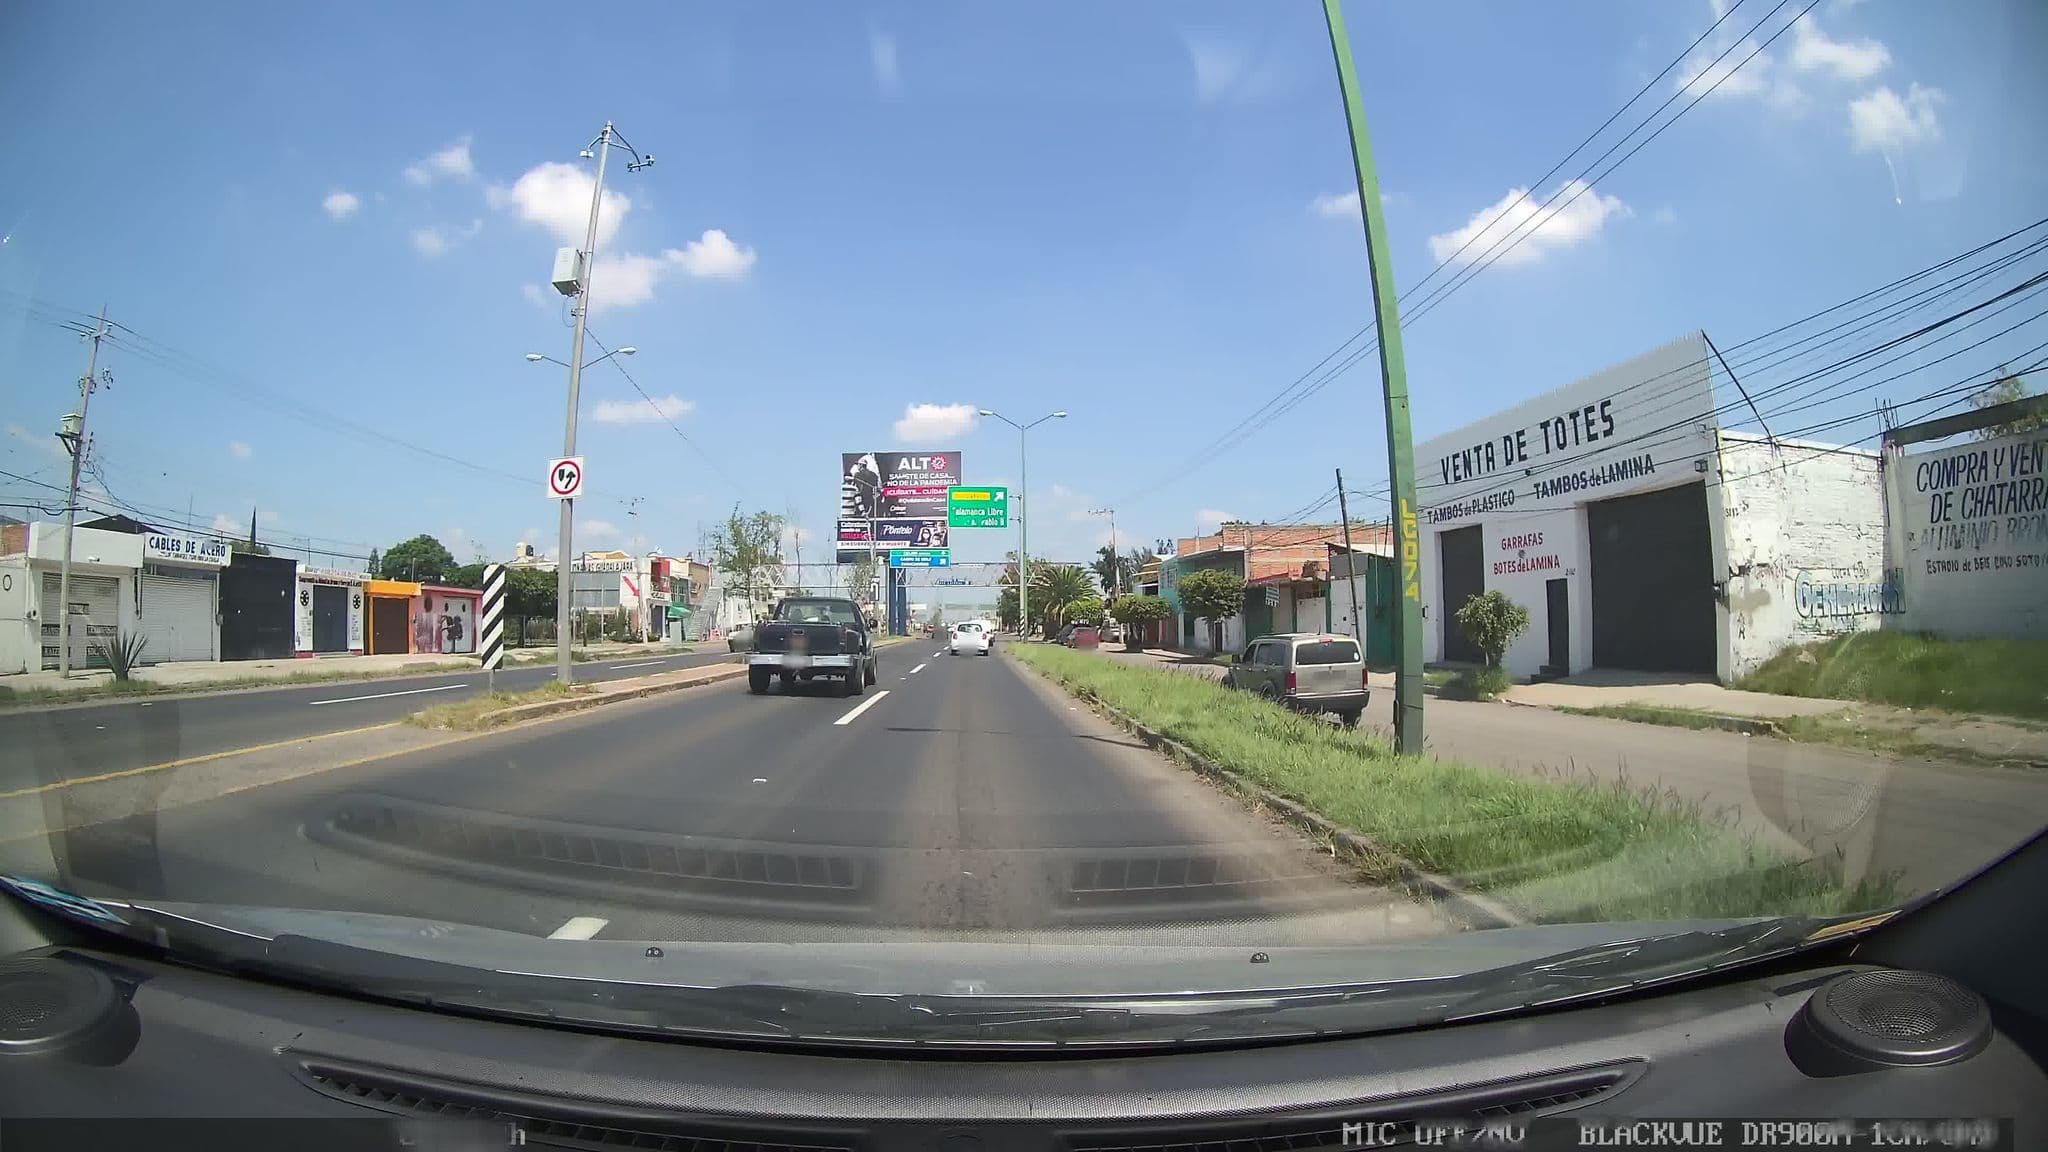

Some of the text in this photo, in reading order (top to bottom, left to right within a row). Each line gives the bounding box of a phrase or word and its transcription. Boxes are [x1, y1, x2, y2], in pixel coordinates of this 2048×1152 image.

[1441, 399, 1615, 484] VENTA DE TOTES
[1534, 471, 1587, 500] TAMBOS
[1600, 453, 1655, 485] LAMINA
[1916, 450, 1988, 492] COMPRA
[1993, 447, 2005, 480] Y
[1427, 503, 1463, 525] TAMBOS
[1472, 489, 1515, 515] PLASTICO
[1930, 490, 1953, 524] DE
[149, 536, 181, 552] CABLES
[186, 540, 196, 554] DE
[1501, 532, 1544, 551] GARRAFAS
[1493, 560, 1516, 575] BOTES
[1525, 554, 1561, 572] LAMINA
[1926, 559, 1959, 575] ESTADIO
